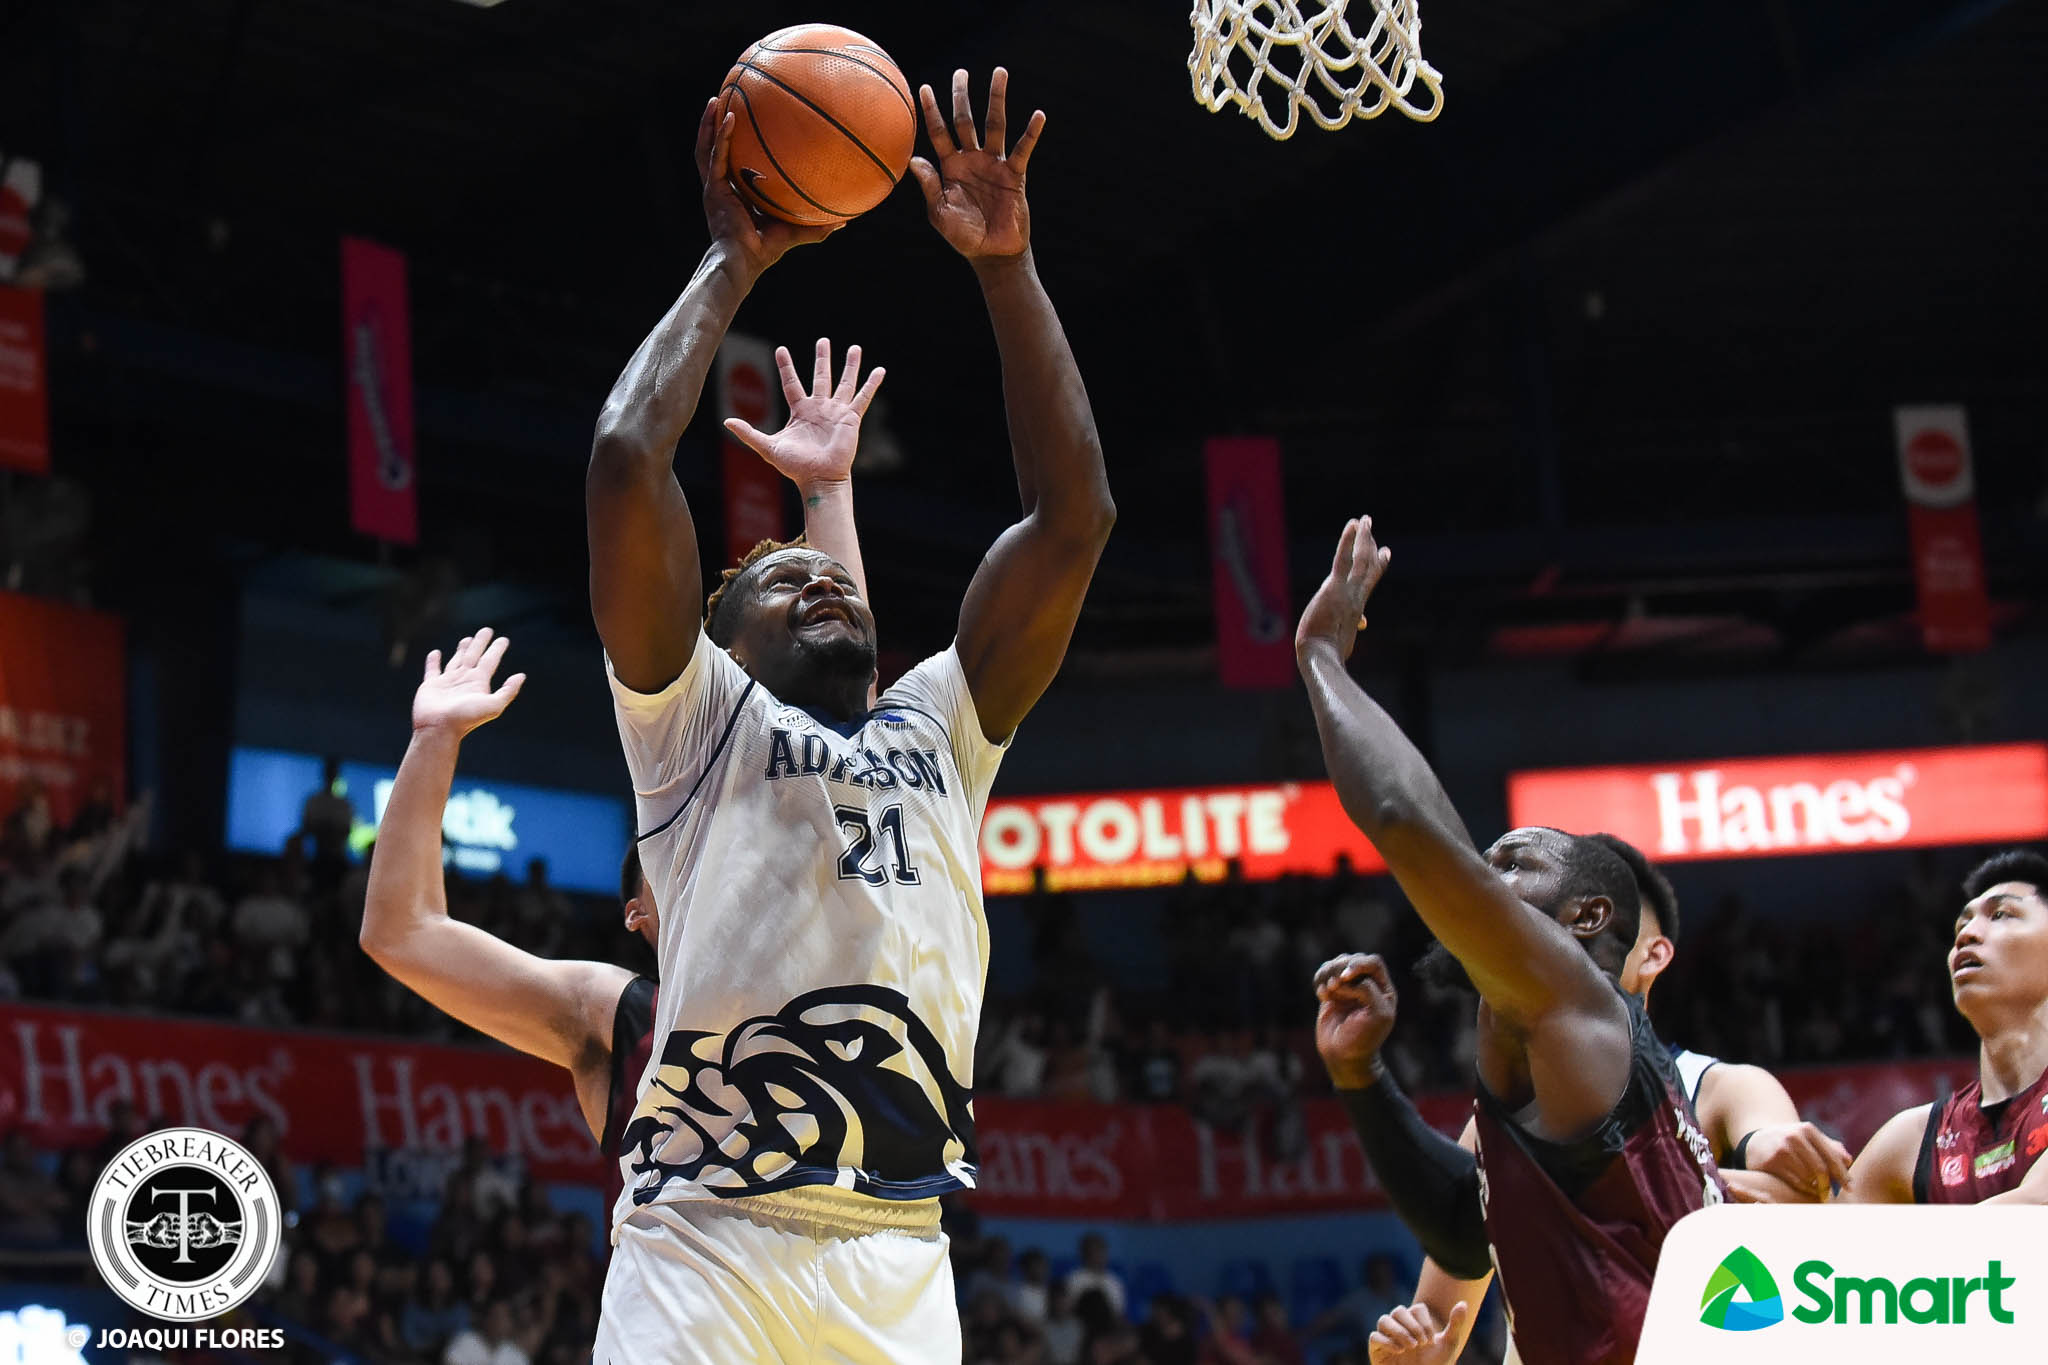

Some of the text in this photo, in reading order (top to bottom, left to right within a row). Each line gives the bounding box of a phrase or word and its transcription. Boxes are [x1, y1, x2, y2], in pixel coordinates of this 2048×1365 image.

[834, 803, 921, 887] 21
[979, 789, 1291, 869] OTOLITE
[1651, 770, 1911, 855] Hanes
[15, 1020, 289, 1139] Hanes
[353, 1055, 604, 1165] Hanes
[977, 1127, 1124, 1201] anes
